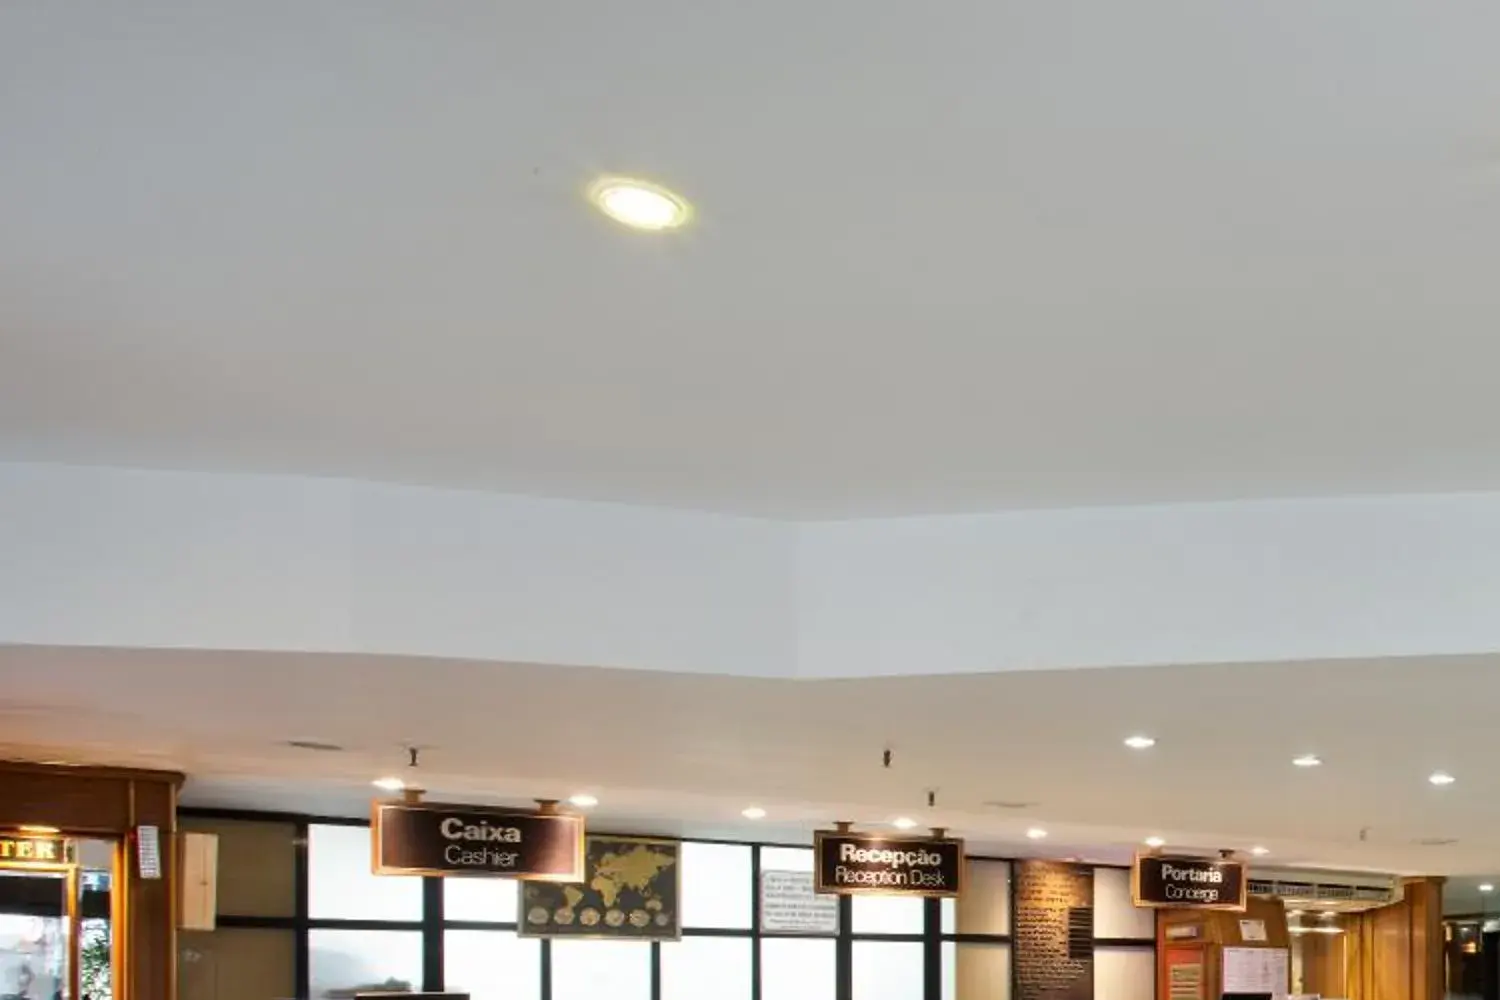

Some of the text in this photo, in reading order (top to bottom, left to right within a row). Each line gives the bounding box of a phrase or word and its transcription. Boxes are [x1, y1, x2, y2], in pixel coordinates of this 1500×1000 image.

[440, 817, 521, 842] Caixa
[444, 844, 519, 867] Cashier
[840, 843, 942, 869] Recepção
[835, 865, 945, 887] Reception Desk
[1161, 863, 1223, 883] Portaria
[1165, 883, 1219, 903] Concierge
